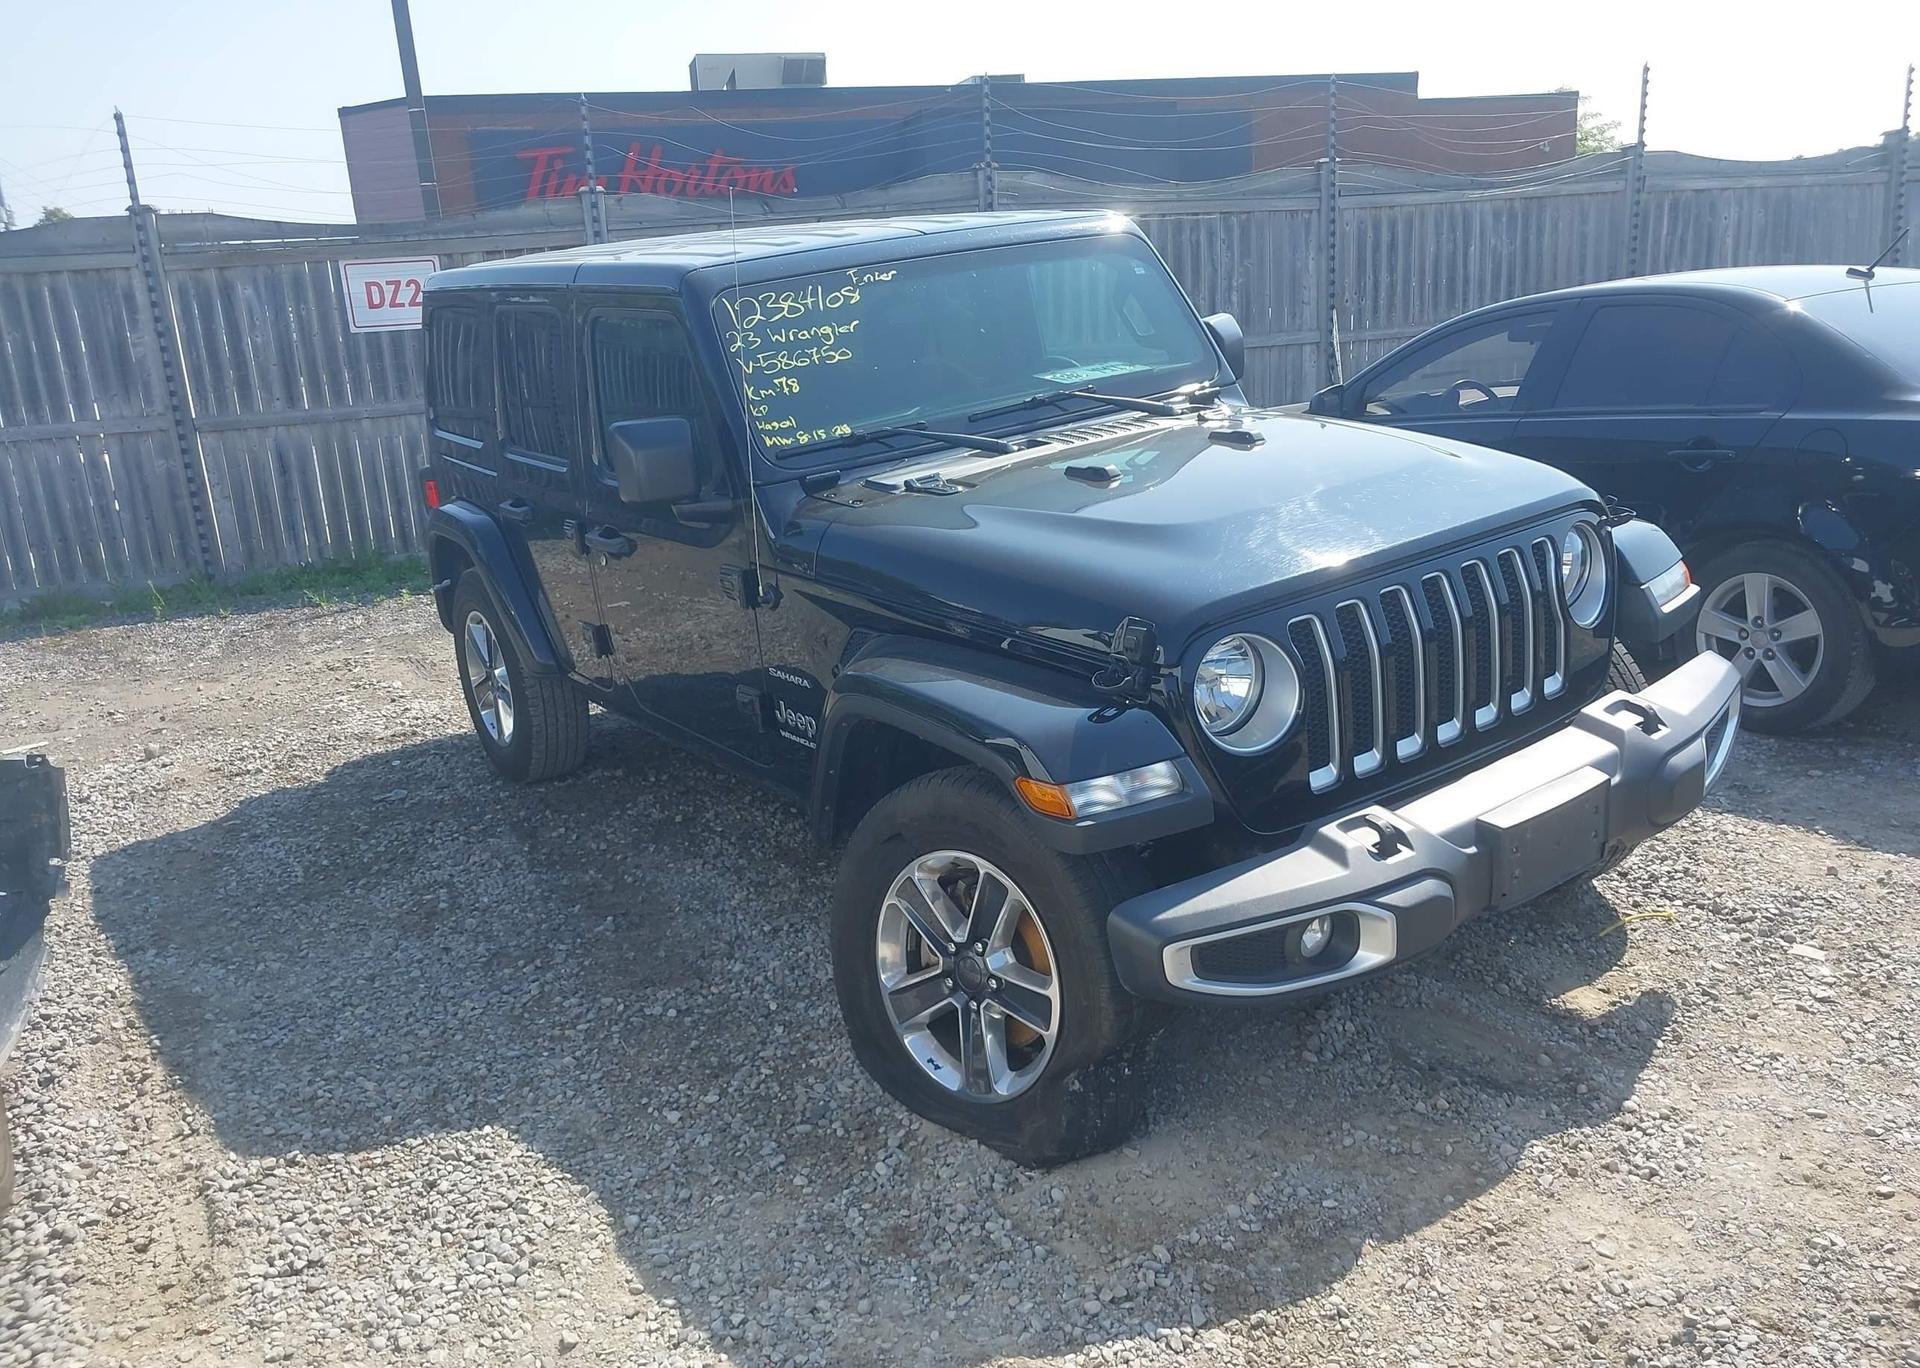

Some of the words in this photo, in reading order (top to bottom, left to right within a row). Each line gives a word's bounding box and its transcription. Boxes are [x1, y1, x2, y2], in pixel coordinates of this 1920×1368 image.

[516, 145, 608, 201] Tim
[615, 140, 799, 199] Hortons
[722, 285, 861, 329] 12384108
[726, 331, 762, 352] 23
[767, 319, 860, 345] Wrangler
[768, 667, 811, 689] SAHARA
[774, 700, 817, 738] Jeep
